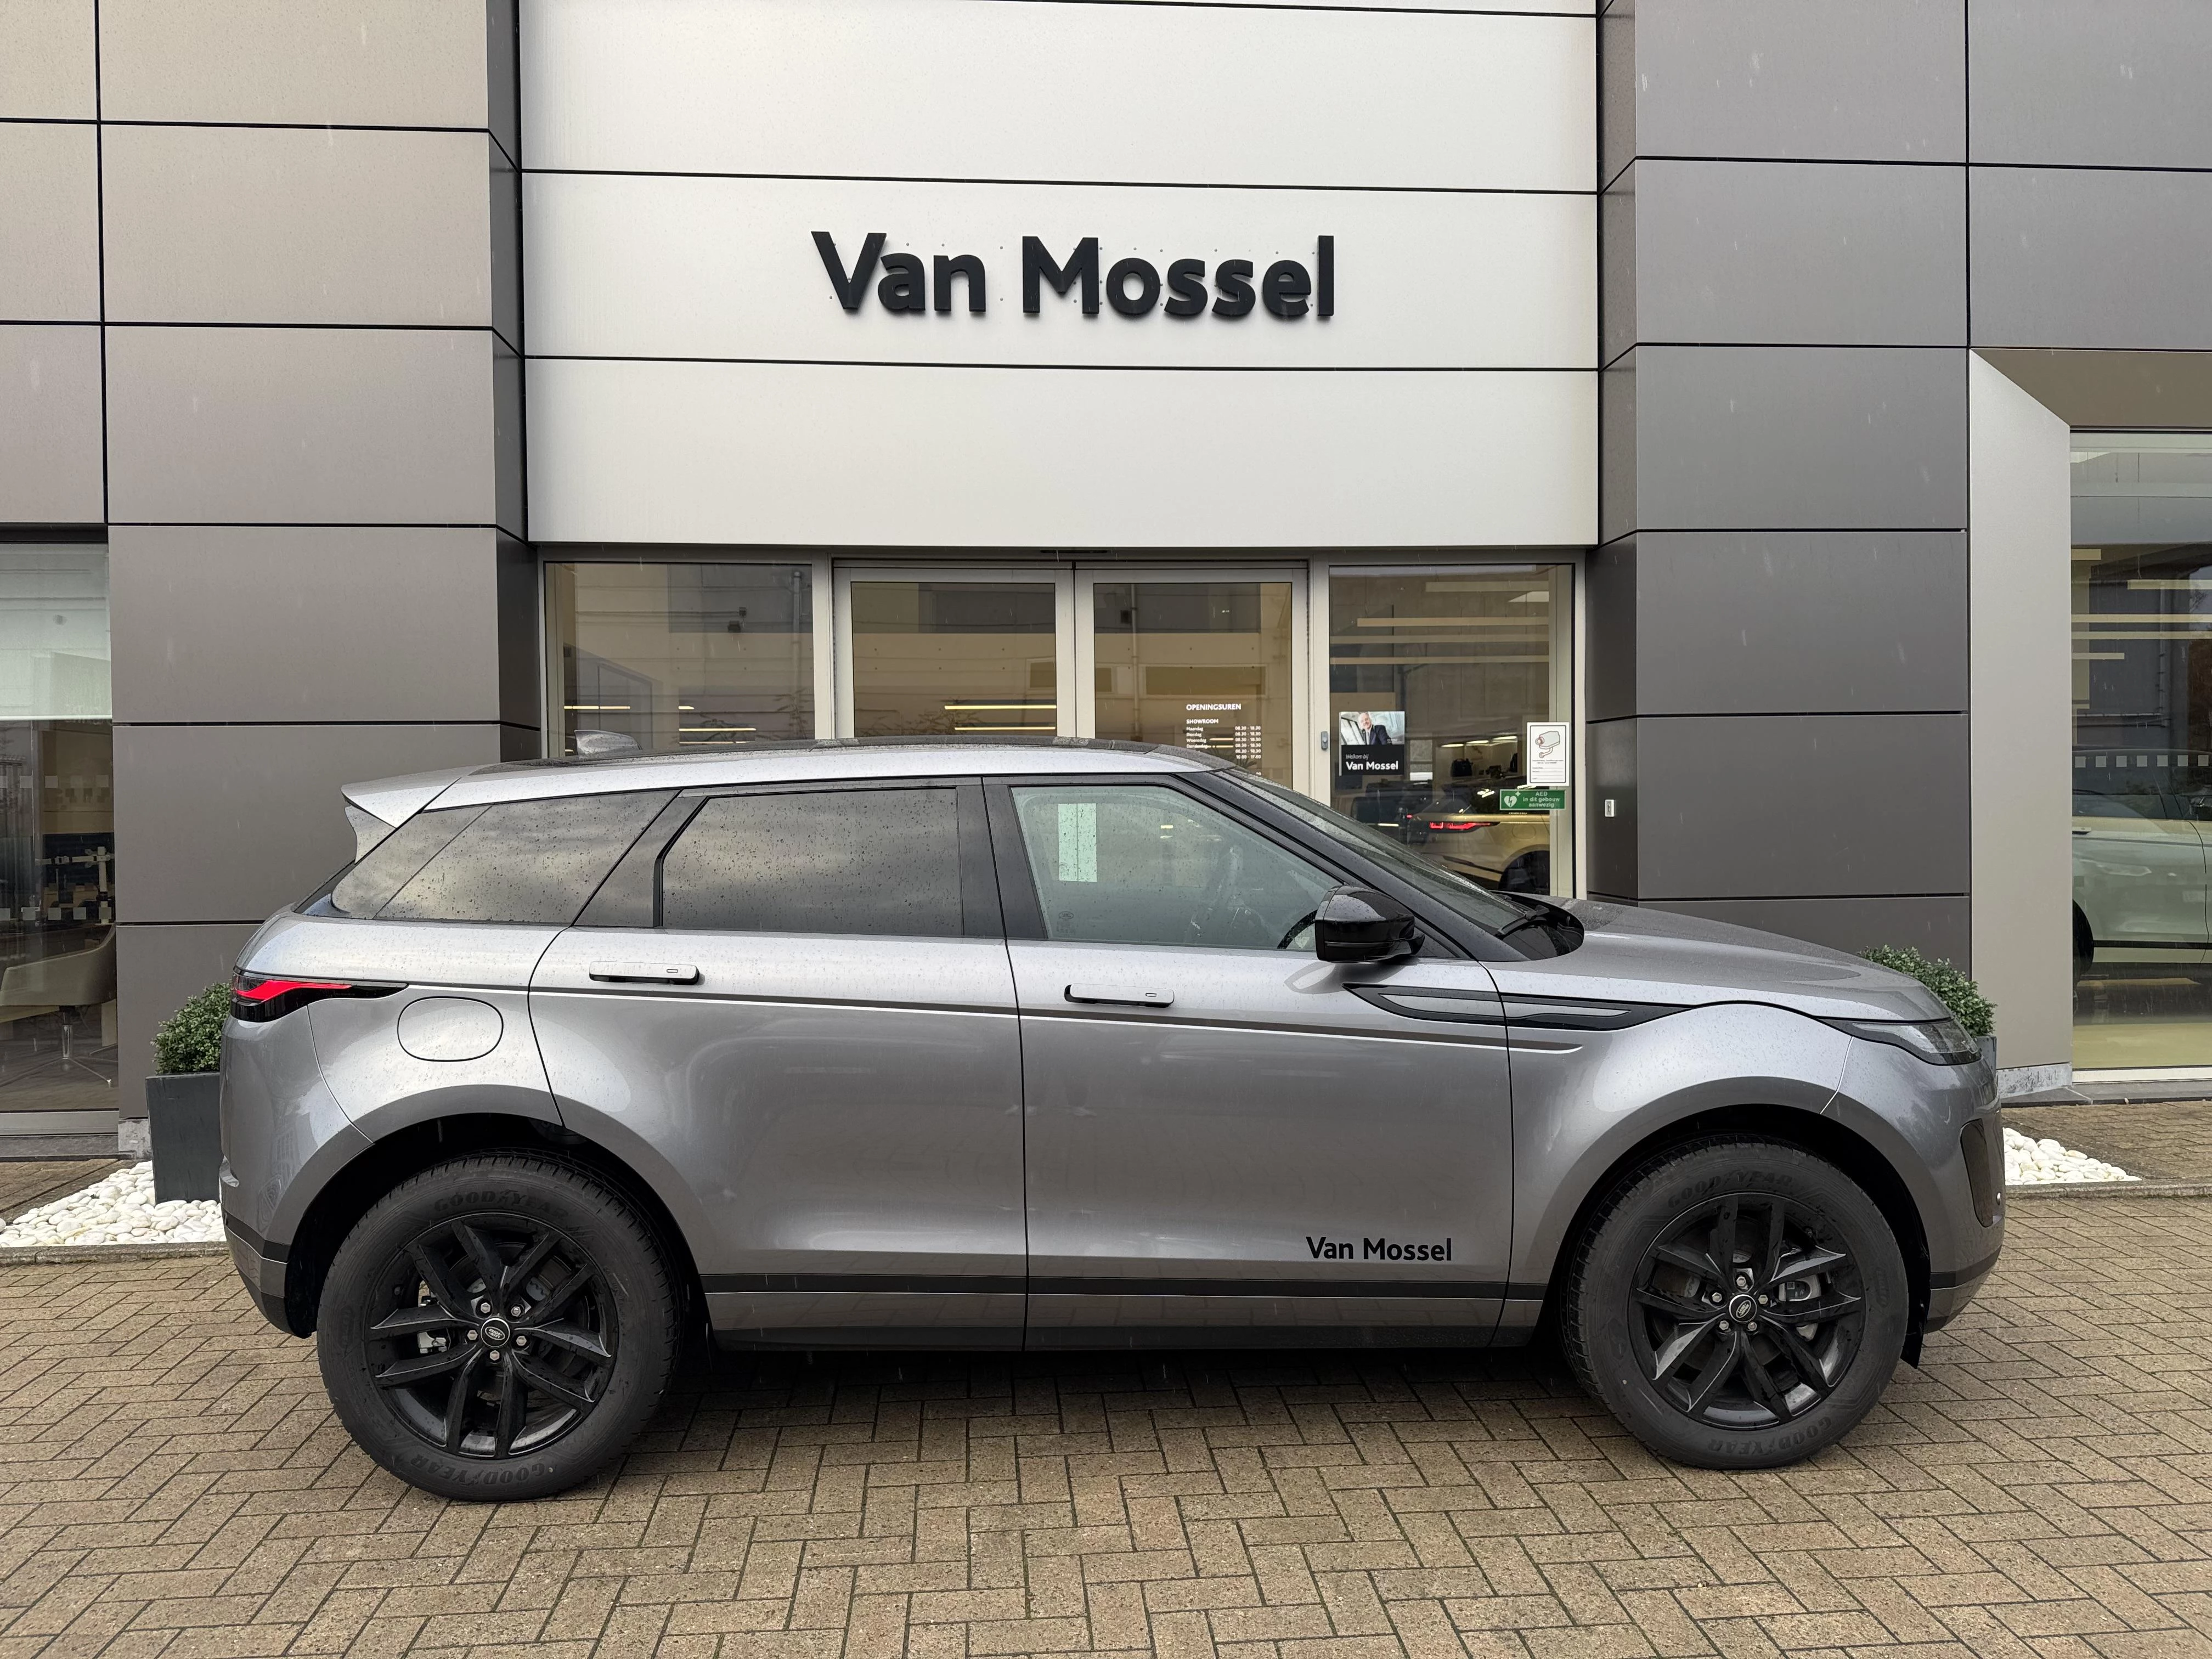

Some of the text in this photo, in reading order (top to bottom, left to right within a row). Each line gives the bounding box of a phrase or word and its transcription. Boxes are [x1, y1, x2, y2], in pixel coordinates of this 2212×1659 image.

[811, 231, 1334, 317] Van Mossel
[1346, 760, 1399, 770] Van Mossel
[1305, 1236, 1452, 1261] Van Mossel
[409, 1455, 545, 1485] GOODYEAR
